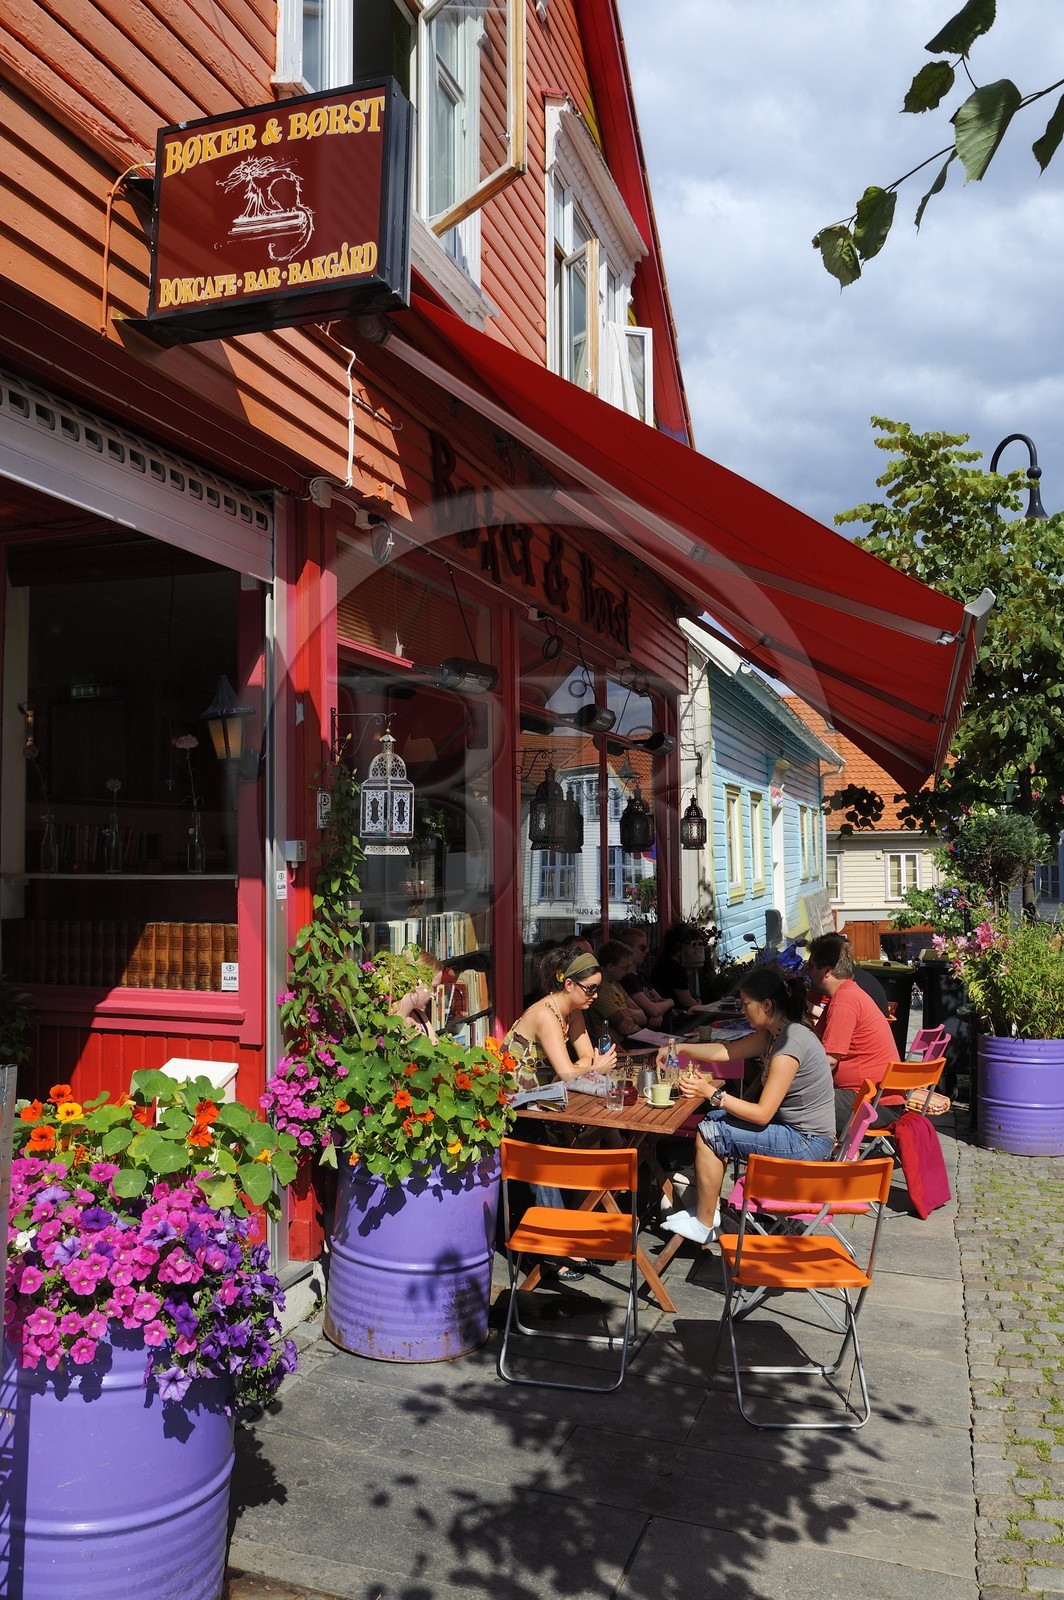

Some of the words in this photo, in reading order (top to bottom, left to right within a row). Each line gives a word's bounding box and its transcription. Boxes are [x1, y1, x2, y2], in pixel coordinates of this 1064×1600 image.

[164, 124, 256, 178] BØKER
[261, 118, 282, 145] &
[288, 96, 385, 140] BØRST
[544, 532, 570, 613] &
